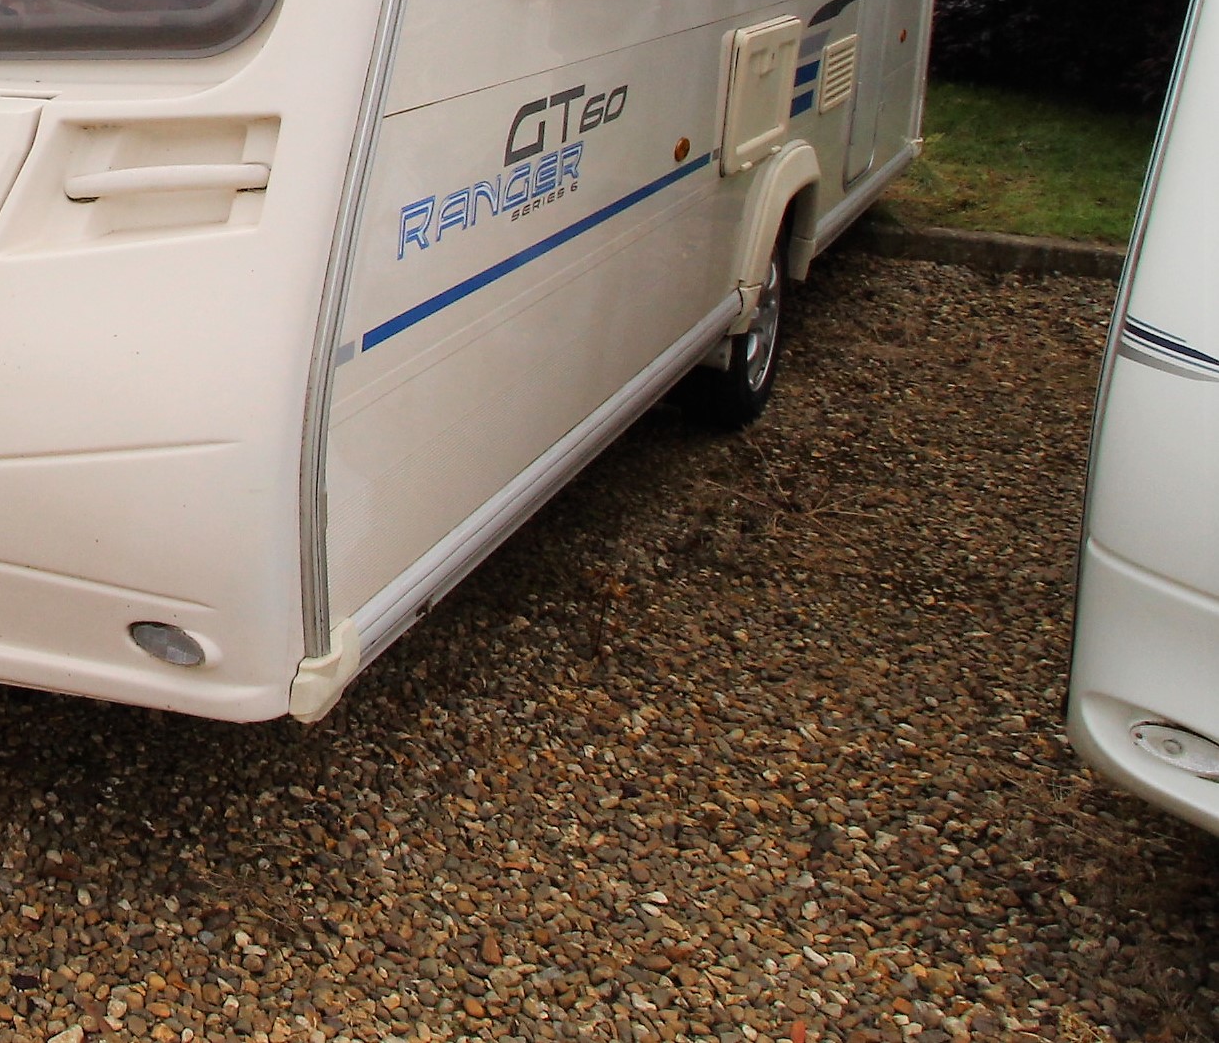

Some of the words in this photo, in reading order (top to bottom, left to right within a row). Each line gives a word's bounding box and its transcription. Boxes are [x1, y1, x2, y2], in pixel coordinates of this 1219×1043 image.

[397, 140, 584, 261] RANGER
[510, 188, 565, 222] SERIES
[570, 181, 578, 193] 6
